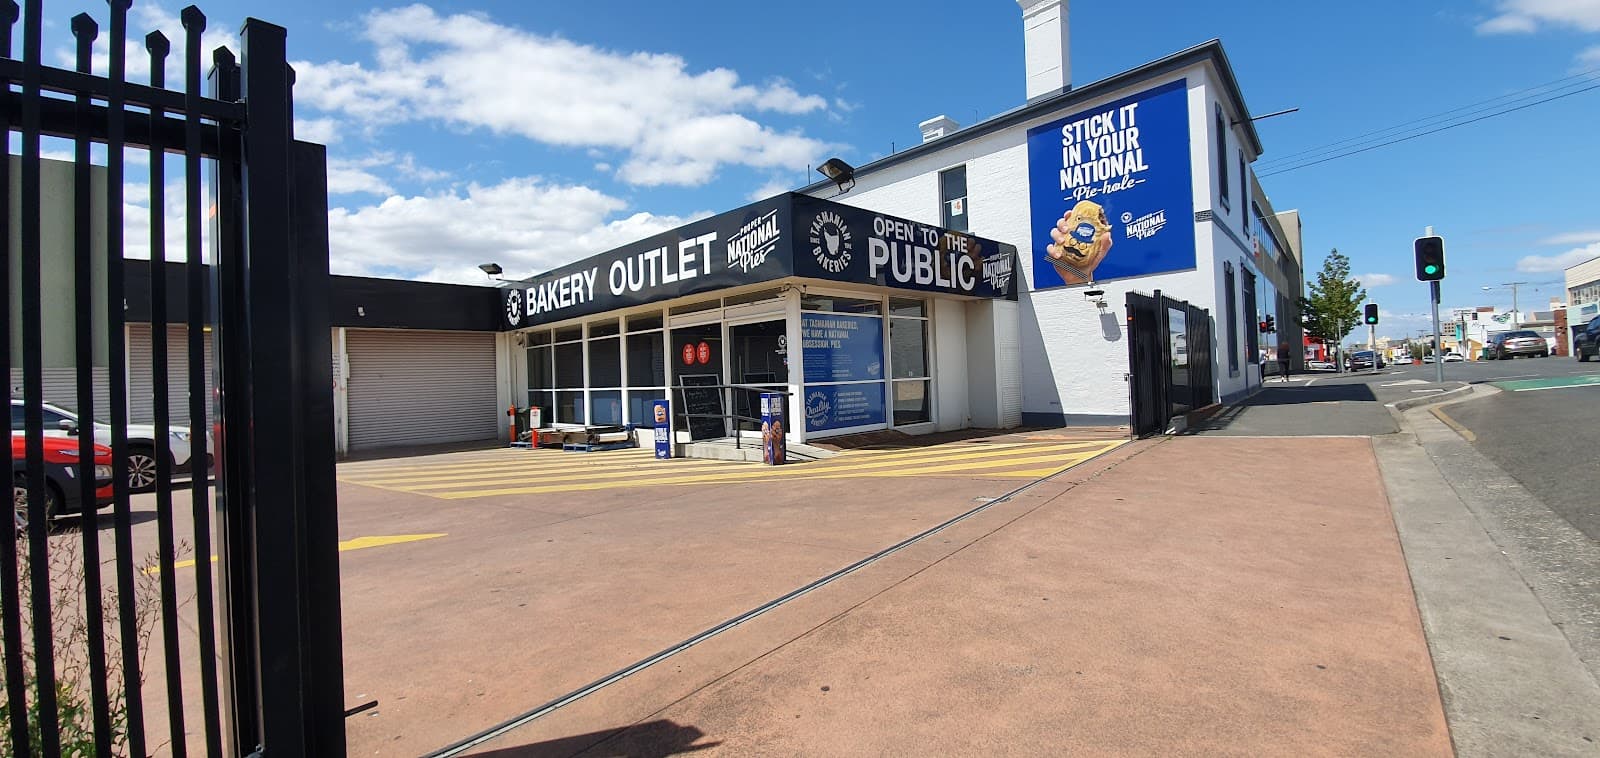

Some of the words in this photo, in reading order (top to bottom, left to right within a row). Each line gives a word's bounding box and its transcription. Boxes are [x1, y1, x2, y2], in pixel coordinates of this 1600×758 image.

[1062, 110, 1115, 146] STICK
[1119, 102, 1138, 130] IT
[1062, 142, 1082, 169] IN
[1086, 126, 1140, 161] YOUR
[1060, 148, 1149, 191] NATIONAL
[727, 214, 780, 264] NATIONAL
[810, 211, 851, 241] TASMANIAN
[873, 216, 914, 243] OPEN
[920, 227, 939, 247] TO
[944, 232, 968, 254] THE
[1126, 212, 1167, 236] NATIONAL
[526, 267, 598, 317] BAKERY
[608, 231, 717, 296] OUTLET
[740, 245, 775, 273] Pies
[812, 246, 852, 273] BAKERIES
[868, 236, 976, 291] PUBLIC
